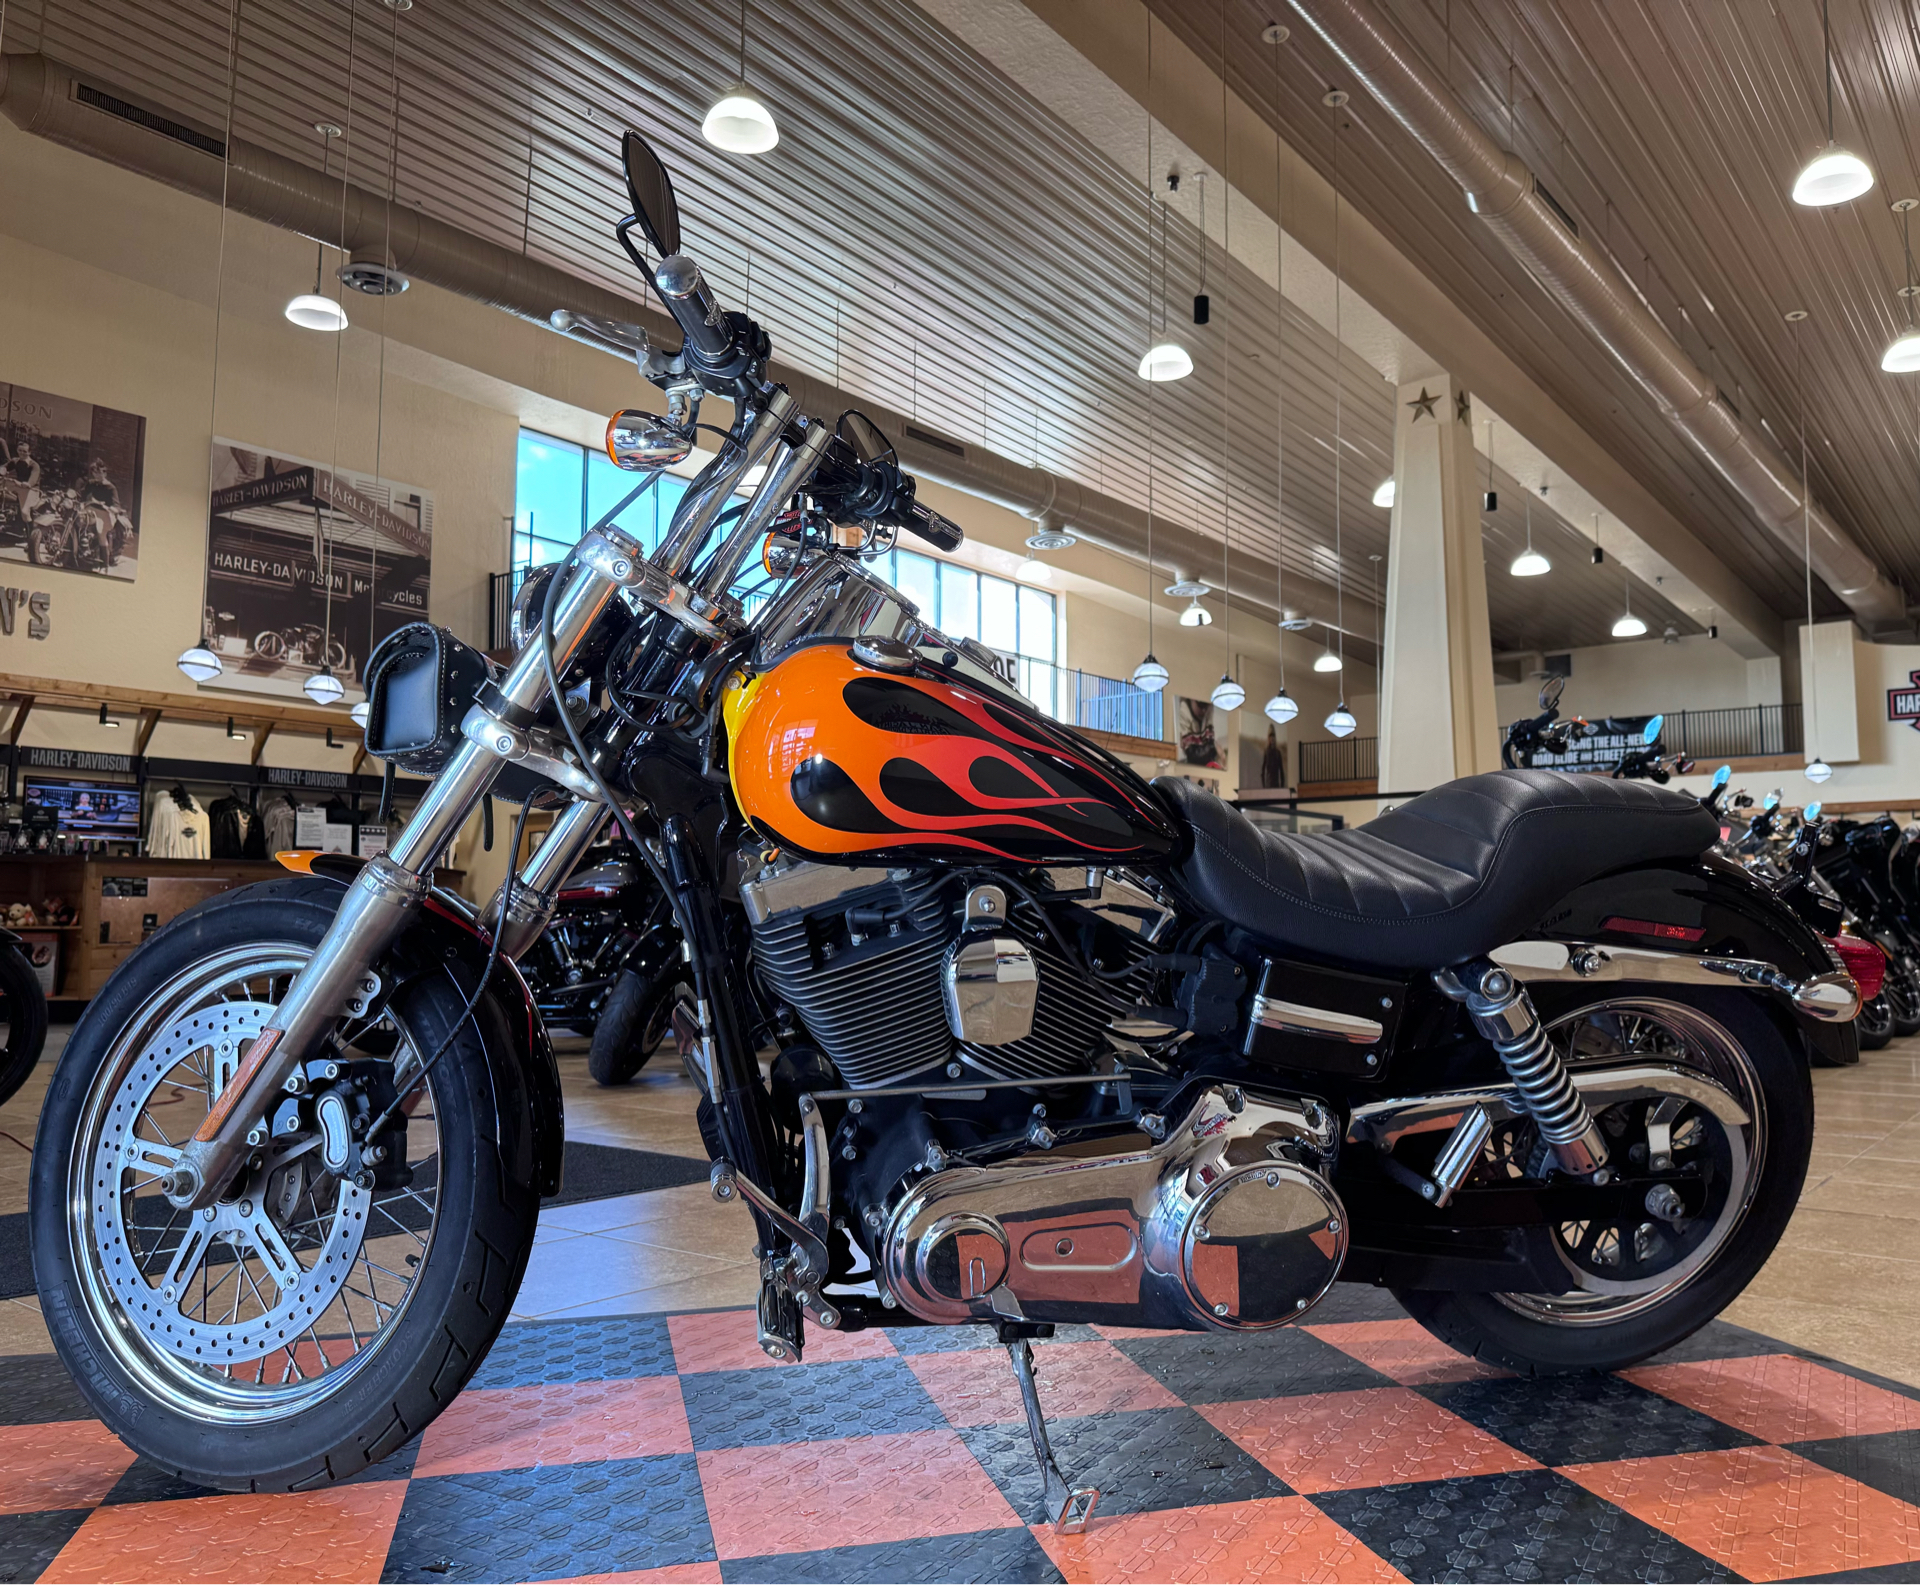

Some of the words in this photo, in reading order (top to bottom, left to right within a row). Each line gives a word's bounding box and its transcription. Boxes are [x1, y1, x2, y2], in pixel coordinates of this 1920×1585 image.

[212, 474, 308, 507] HARLEY-DAVIDSON
[323, 478, 430, 550] HARLEY-DAVIDSON
[214, 552, 344, 590] HARLEY-DAVIDSON
[1593, 735, 1609, 749] THE
[30, 749, 131, 772] HARLEY-DAVIDSON
[1532, 753, 1554, 766] ROAD
[268, 768, 348, 788] HARLEY-DAVIDSON
[51, 1289, 120, 1403] MICHELIN
[358, 1330, 414, 1400] SCORCHER
